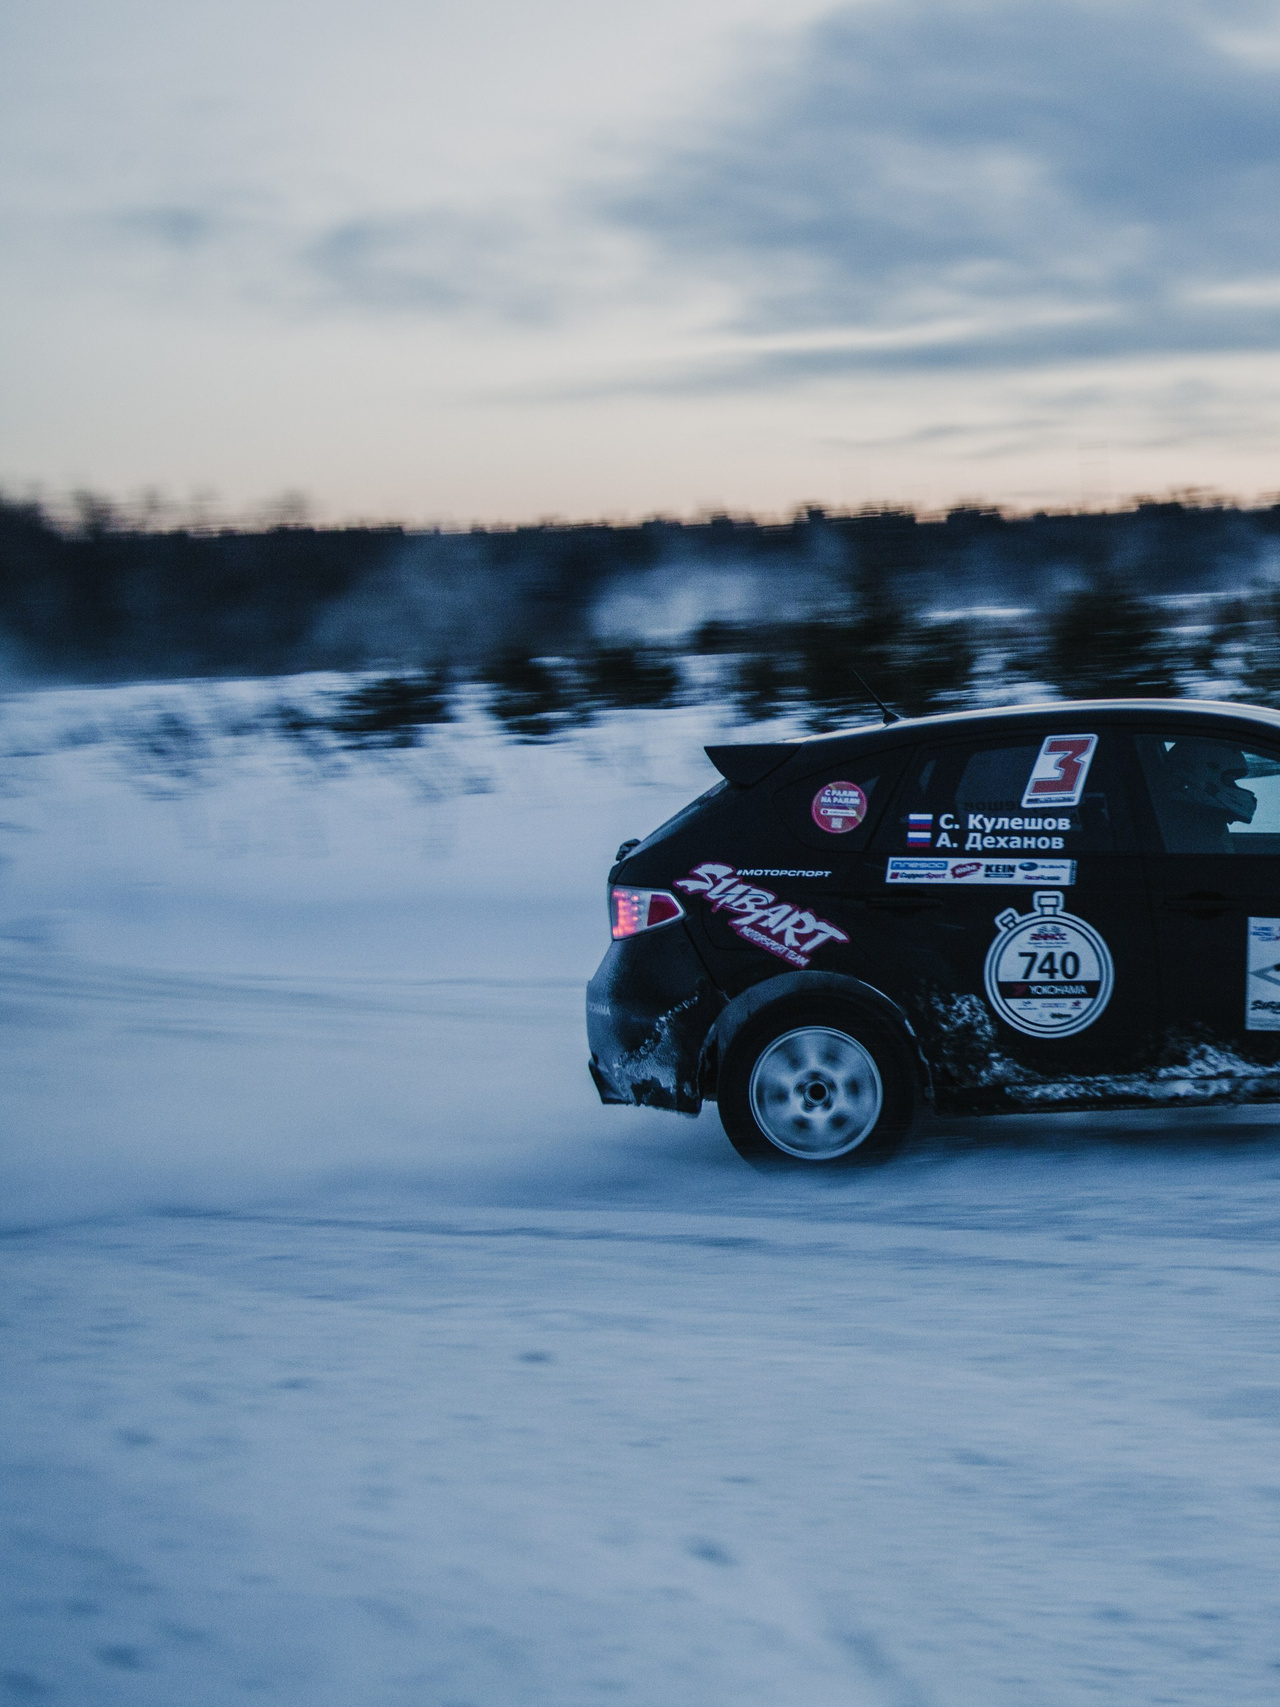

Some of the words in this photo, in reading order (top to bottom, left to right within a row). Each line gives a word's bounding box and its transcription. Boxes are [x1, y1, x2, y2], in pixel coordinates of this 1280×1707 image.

[1031, 739, 1093, 795] 3
[939, 814, 960, 830] С.
[968, 814, 1071, 833] Кулешов
[936, 832, 958, 849] А.
[965, 832, 1065, 851] Деханов
[984, 863, 1016, 873] KEIN
[1018, 951, 1081, 980] 740
[1028, 985, 1088, 995] YOKOHAMA
